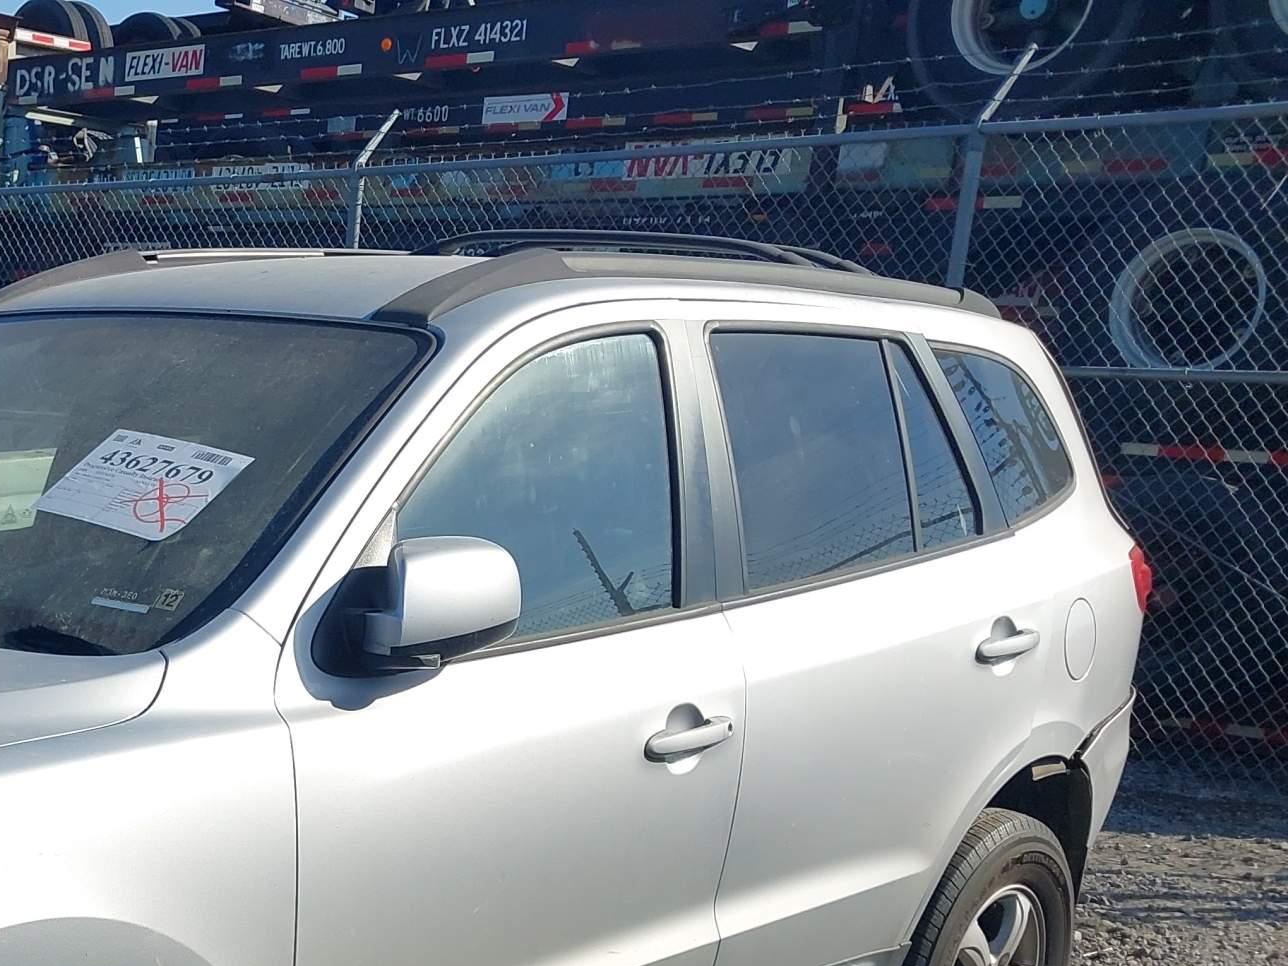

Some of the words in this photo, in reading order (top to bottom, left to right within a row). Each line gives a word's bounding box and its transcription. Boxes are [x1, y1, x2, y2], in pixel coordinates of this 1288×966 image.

[430, 25, 471, 49] FLXZ
[473, 19, 528, 46] 414321
[126, 48, 204, 78] FLEXI-VAN
[484, 104, 521, 116] FLEXI
[523, 102, 552, 114] VAN
[99, 449, 214, 485] 43627679
[160, 591, 179, 608] 12
